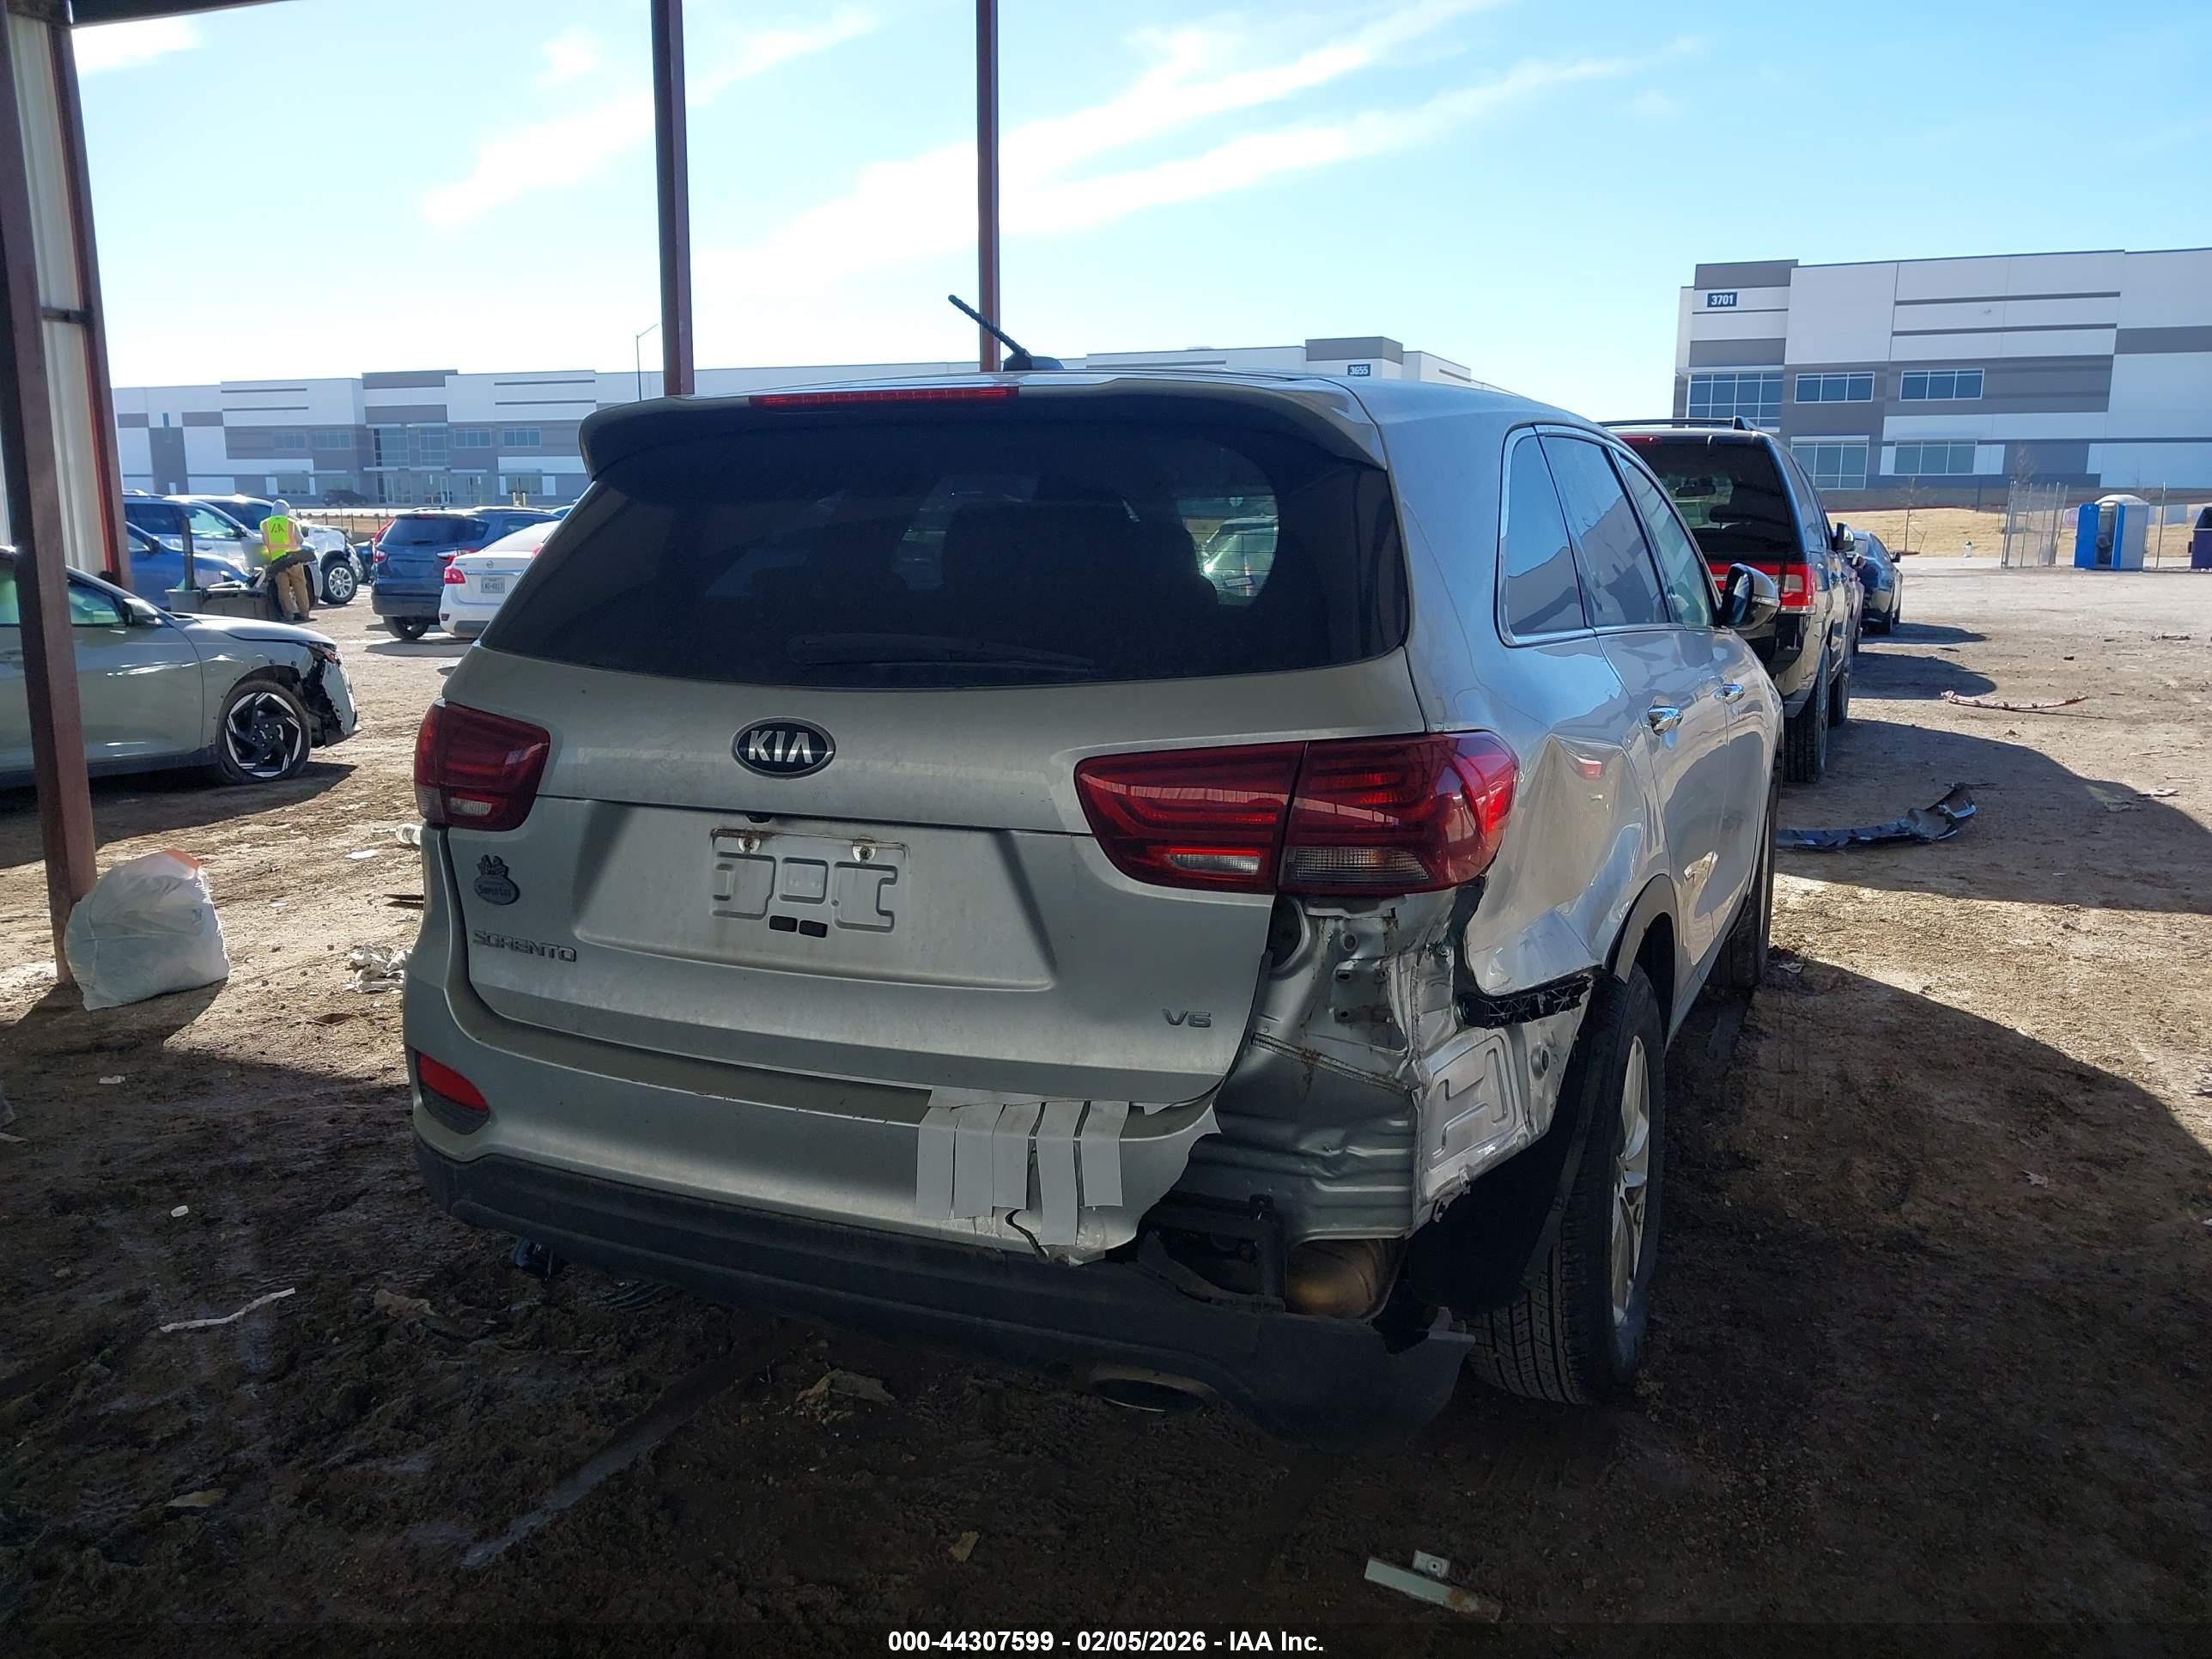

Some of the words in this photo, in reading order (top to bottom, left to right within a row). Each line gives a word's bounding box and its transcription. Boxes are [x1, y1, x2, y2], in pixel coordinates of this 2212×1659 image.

[1711, 295, 1734, 306] 3701
[1349, 366, 1369, 375] 3655
[748, 730, 814, 764] KIA
[472, 928, 577, 963] SORENTO
[1162, 1009, 1211, 1028] V6
